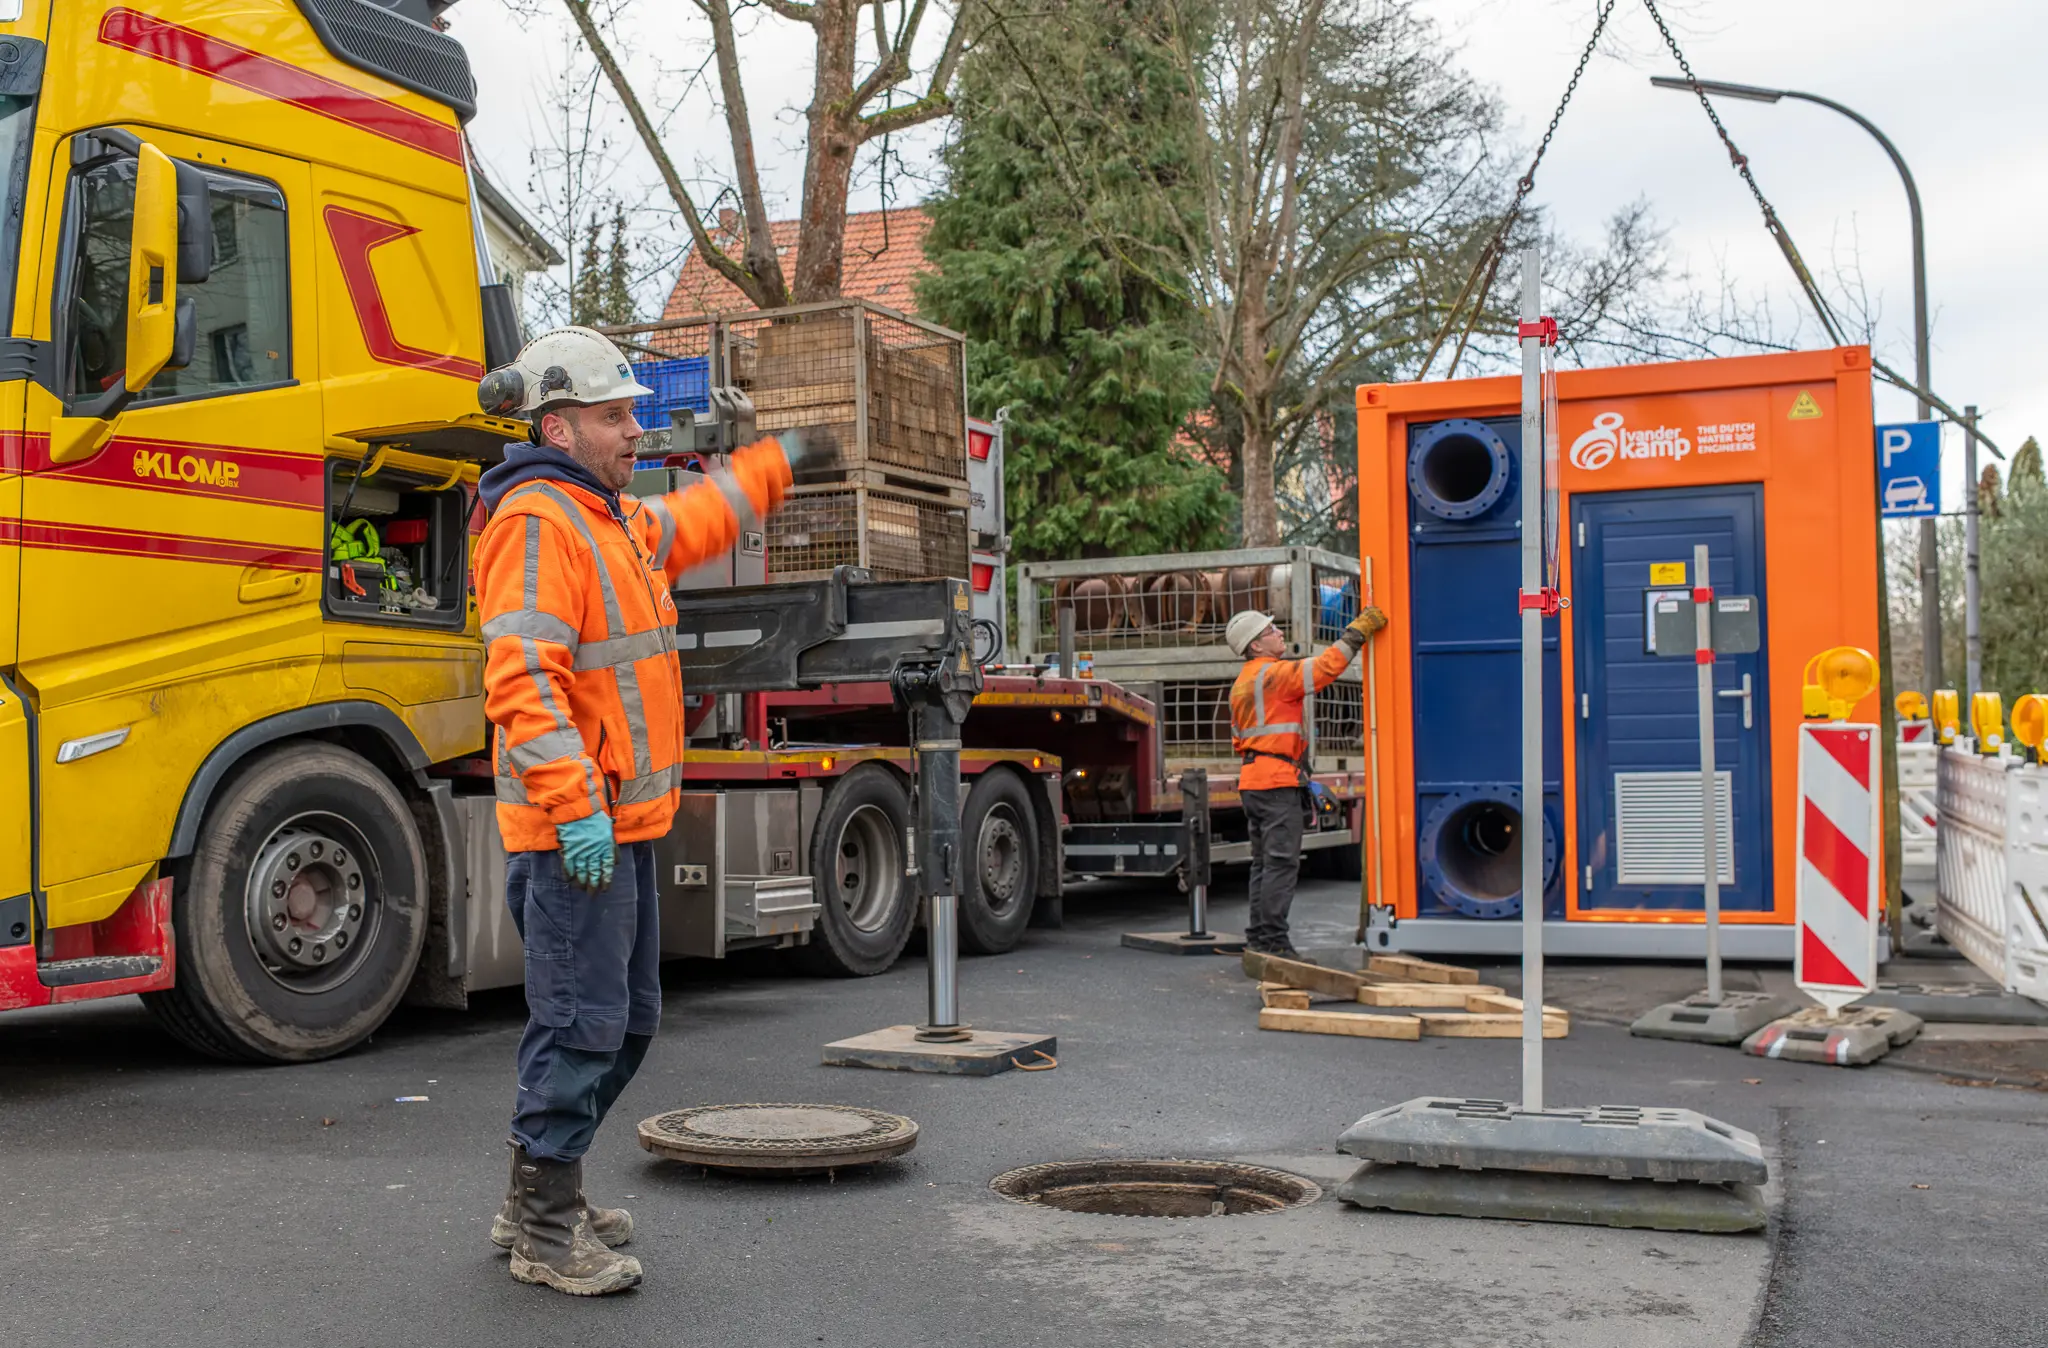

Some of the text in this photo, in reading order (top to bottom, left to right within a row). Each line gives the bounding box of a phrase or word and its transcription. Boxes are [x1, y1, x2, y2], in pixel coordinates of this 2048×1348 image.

[1626, 425, 1682, 441] vander
[1697, 422, 1756, 435] THE DUTCH
[1620, 428, 1691, 461] kamp
[1697, 434, 1733, 445] WATER
[1697, 441, 1756, 454] ENGINEERS
[1883, 429, 1912, 468] P
[138, 450, 240, 487] KLOMP
